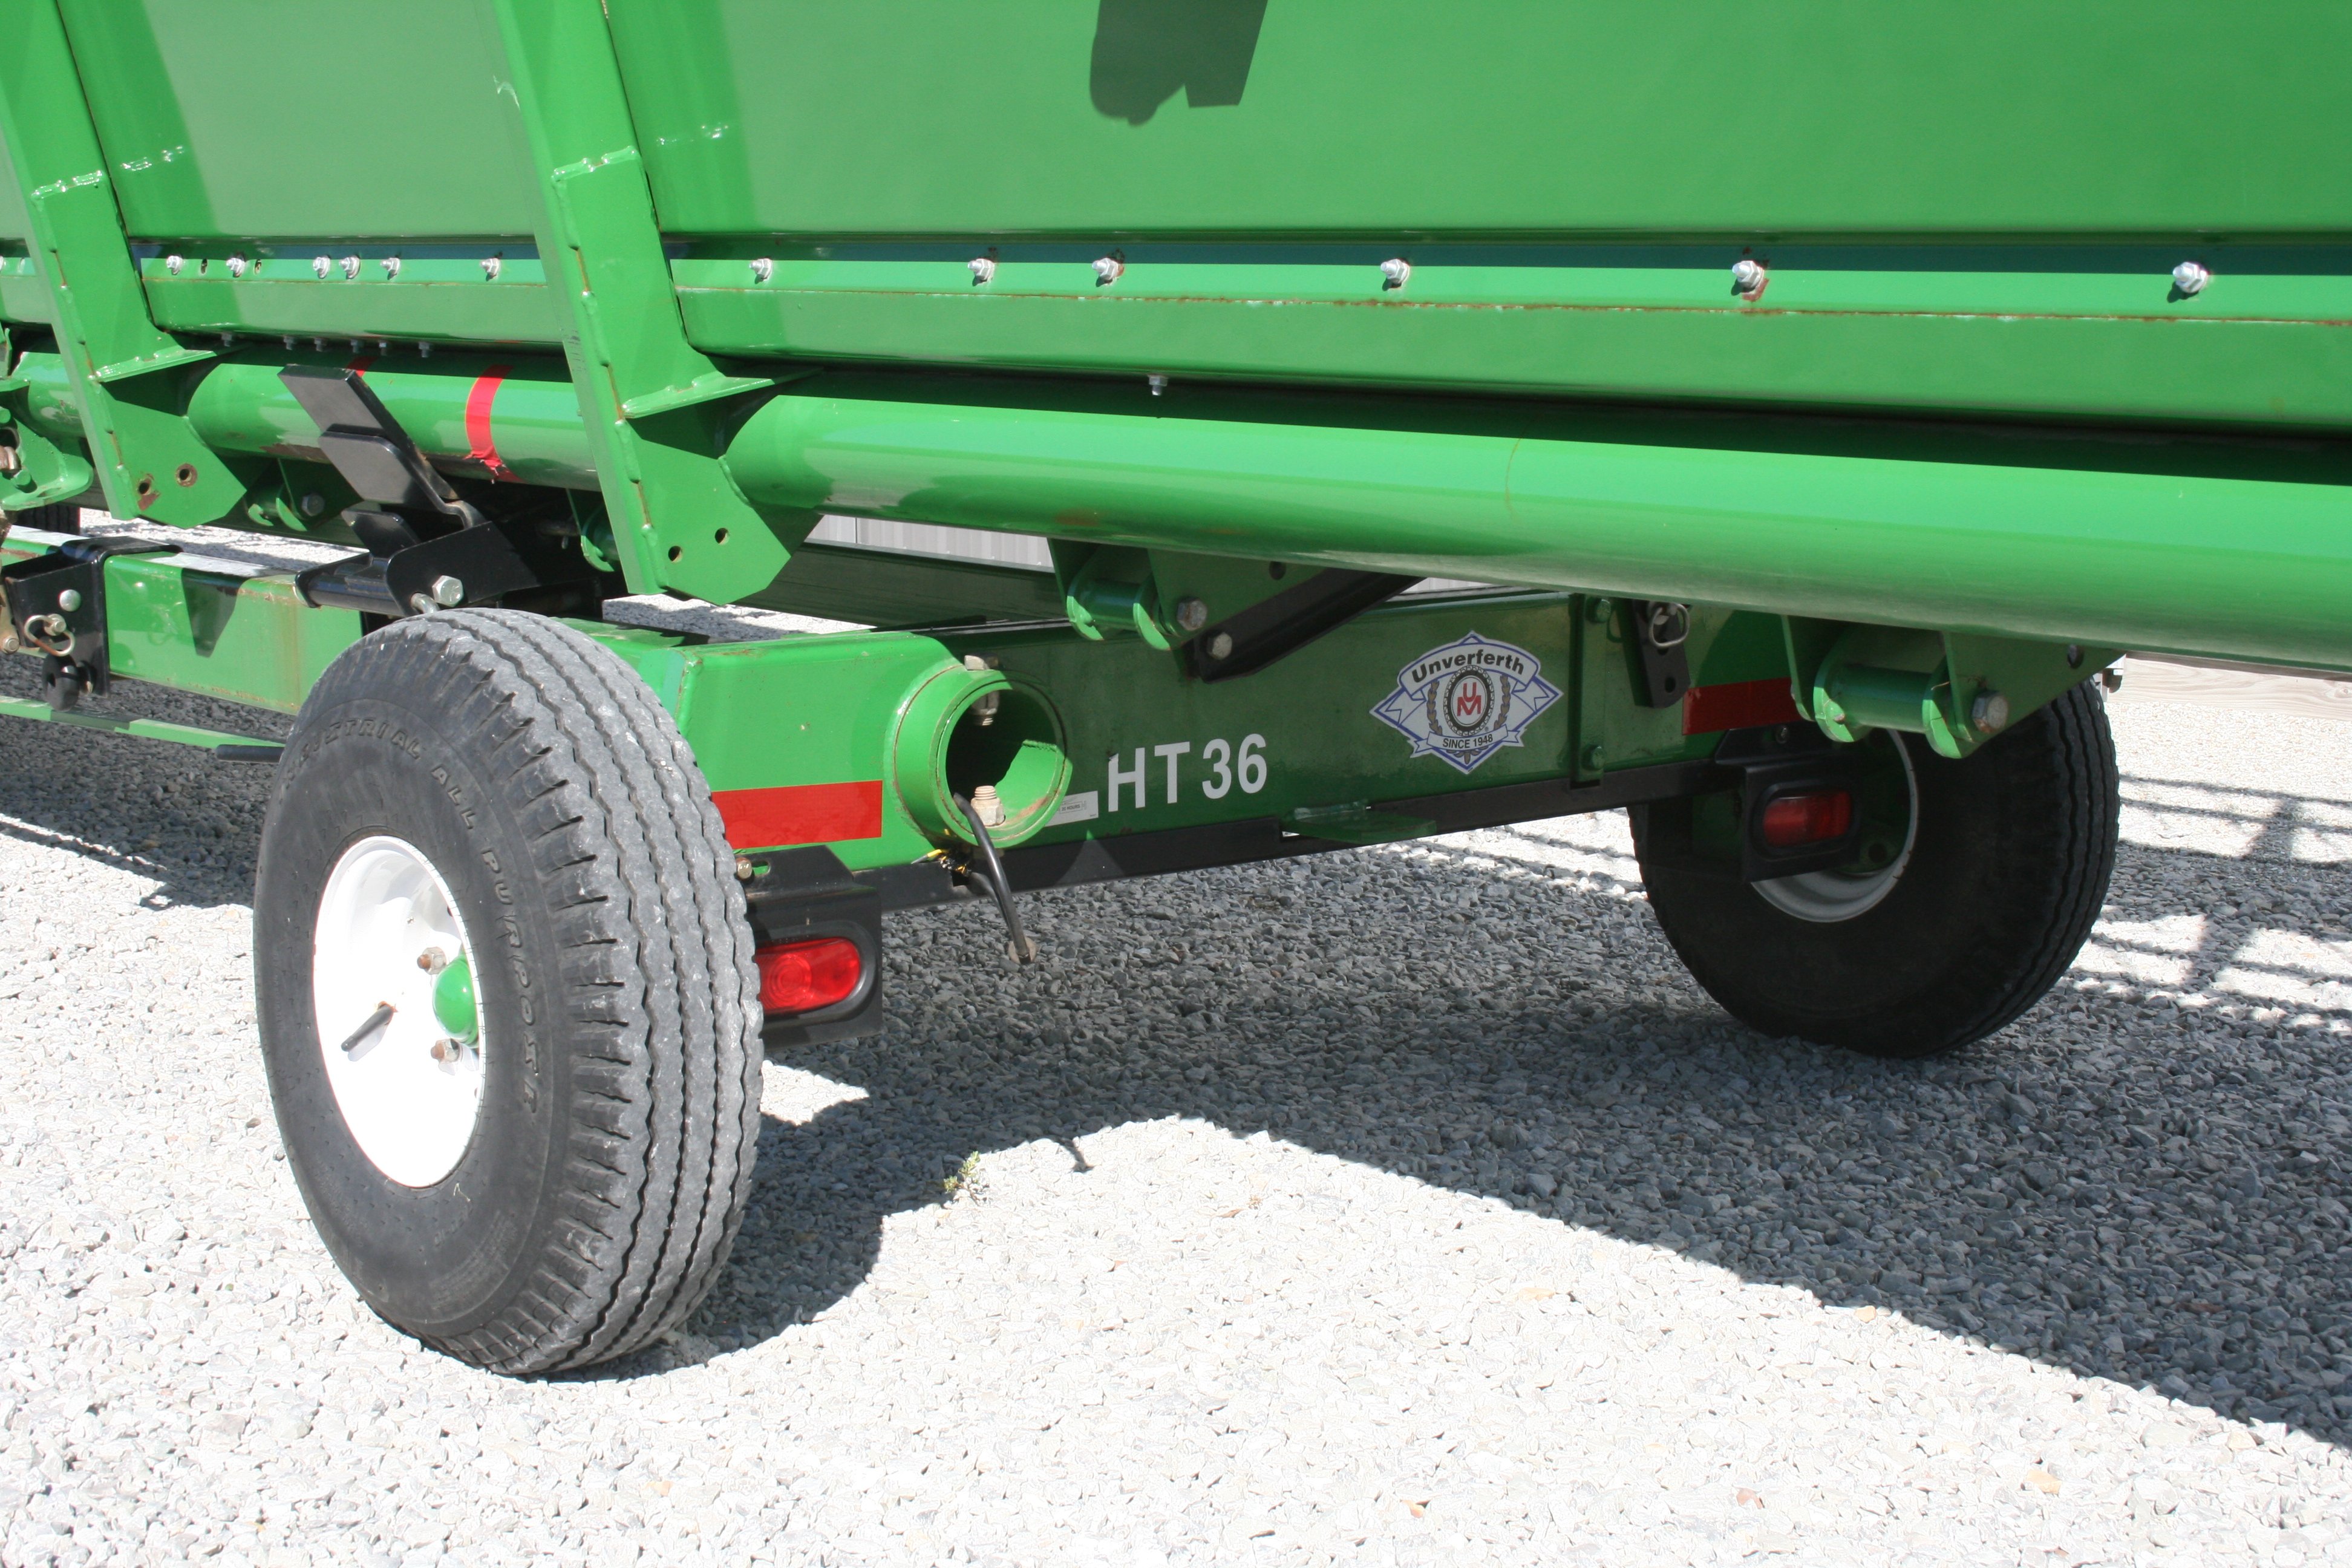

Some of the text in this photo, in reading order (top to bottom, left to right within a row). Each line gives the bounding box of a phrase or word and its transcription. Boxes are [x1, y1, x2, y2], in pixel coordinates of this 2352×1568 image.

[1412, 649, 1524, 683] Unverferth
[1442, 734, 1494, 750] SINCE 1948
[431, 763, 477, 831] ALL
[1108, 733, 1267, 812] HT 36
